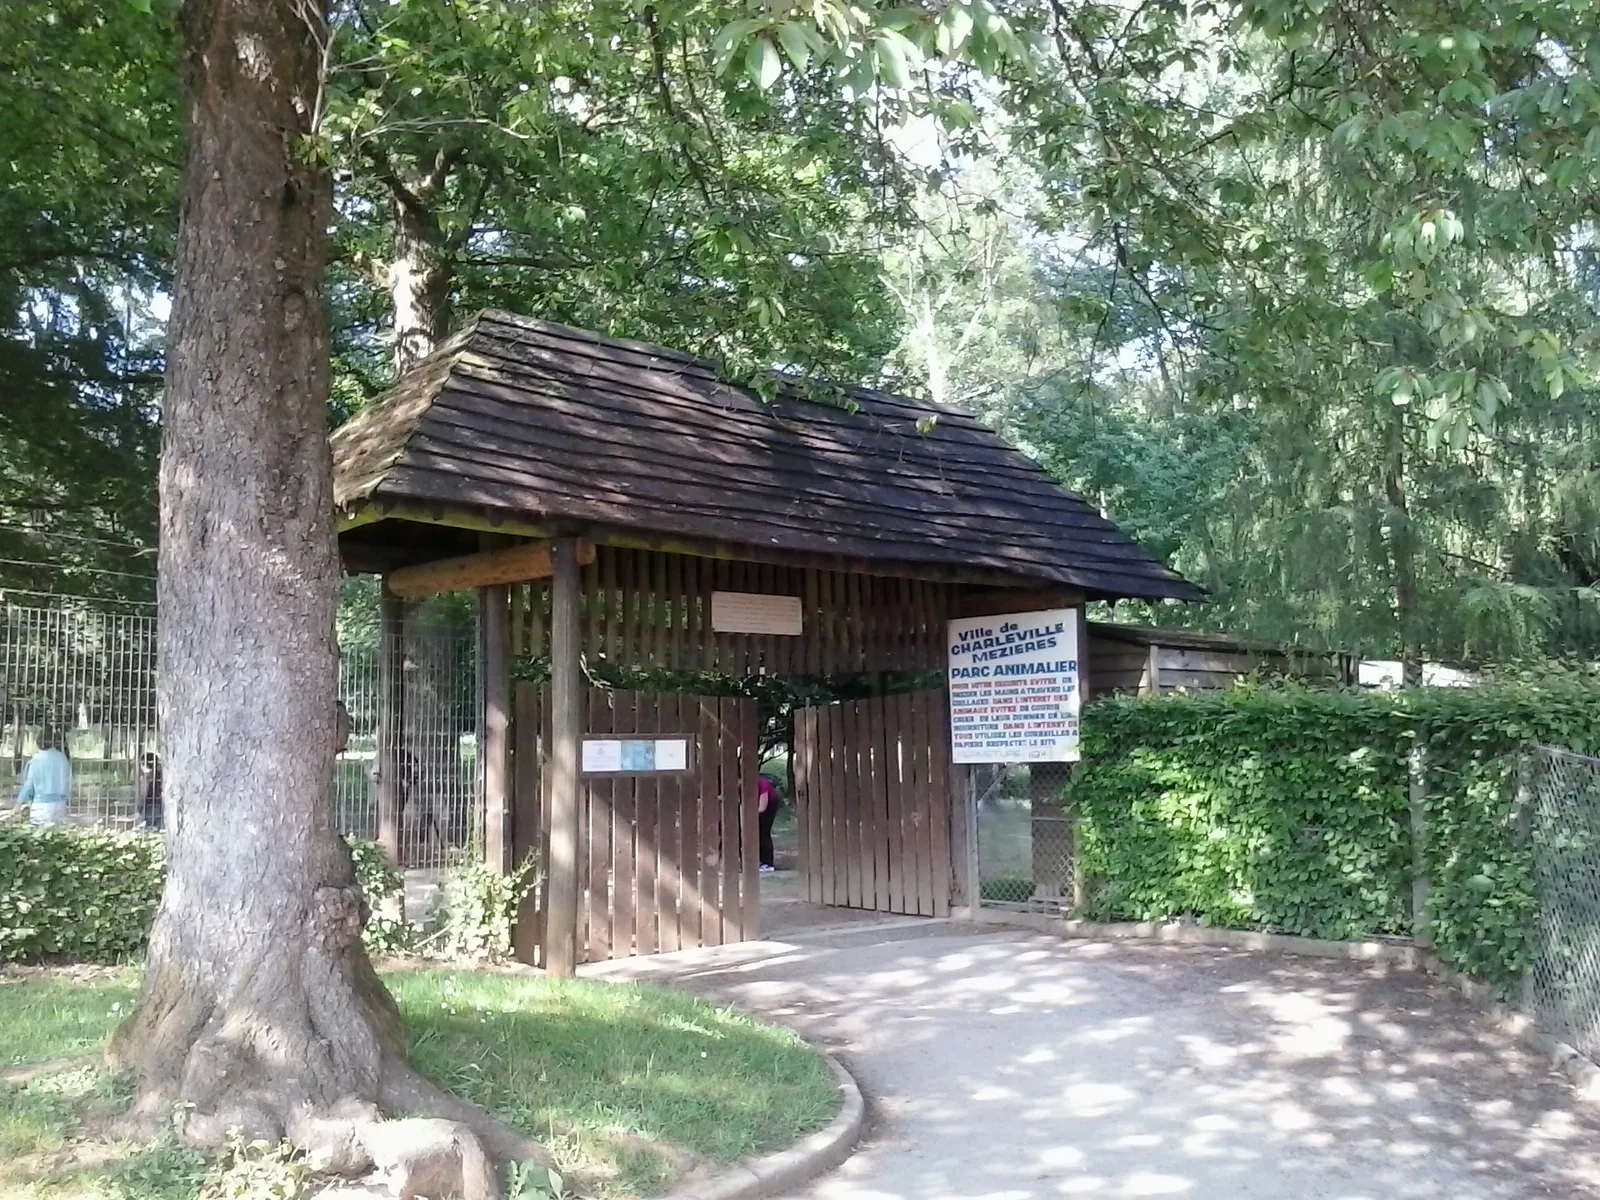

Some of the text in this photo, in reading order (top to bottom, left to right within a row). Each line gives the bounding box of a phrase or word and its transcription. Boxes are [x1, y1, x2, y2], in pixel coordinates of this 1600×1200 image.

[951, 623, 1065, 655] CHARLEVILLE
[958, 622, 1018, 642] Ville de
[972, 637, 1057, 663] MEZIERES
[951, 660, 1077, 679] PARC ANIMALIER
[995, 688, 1018, 696] MAINS
